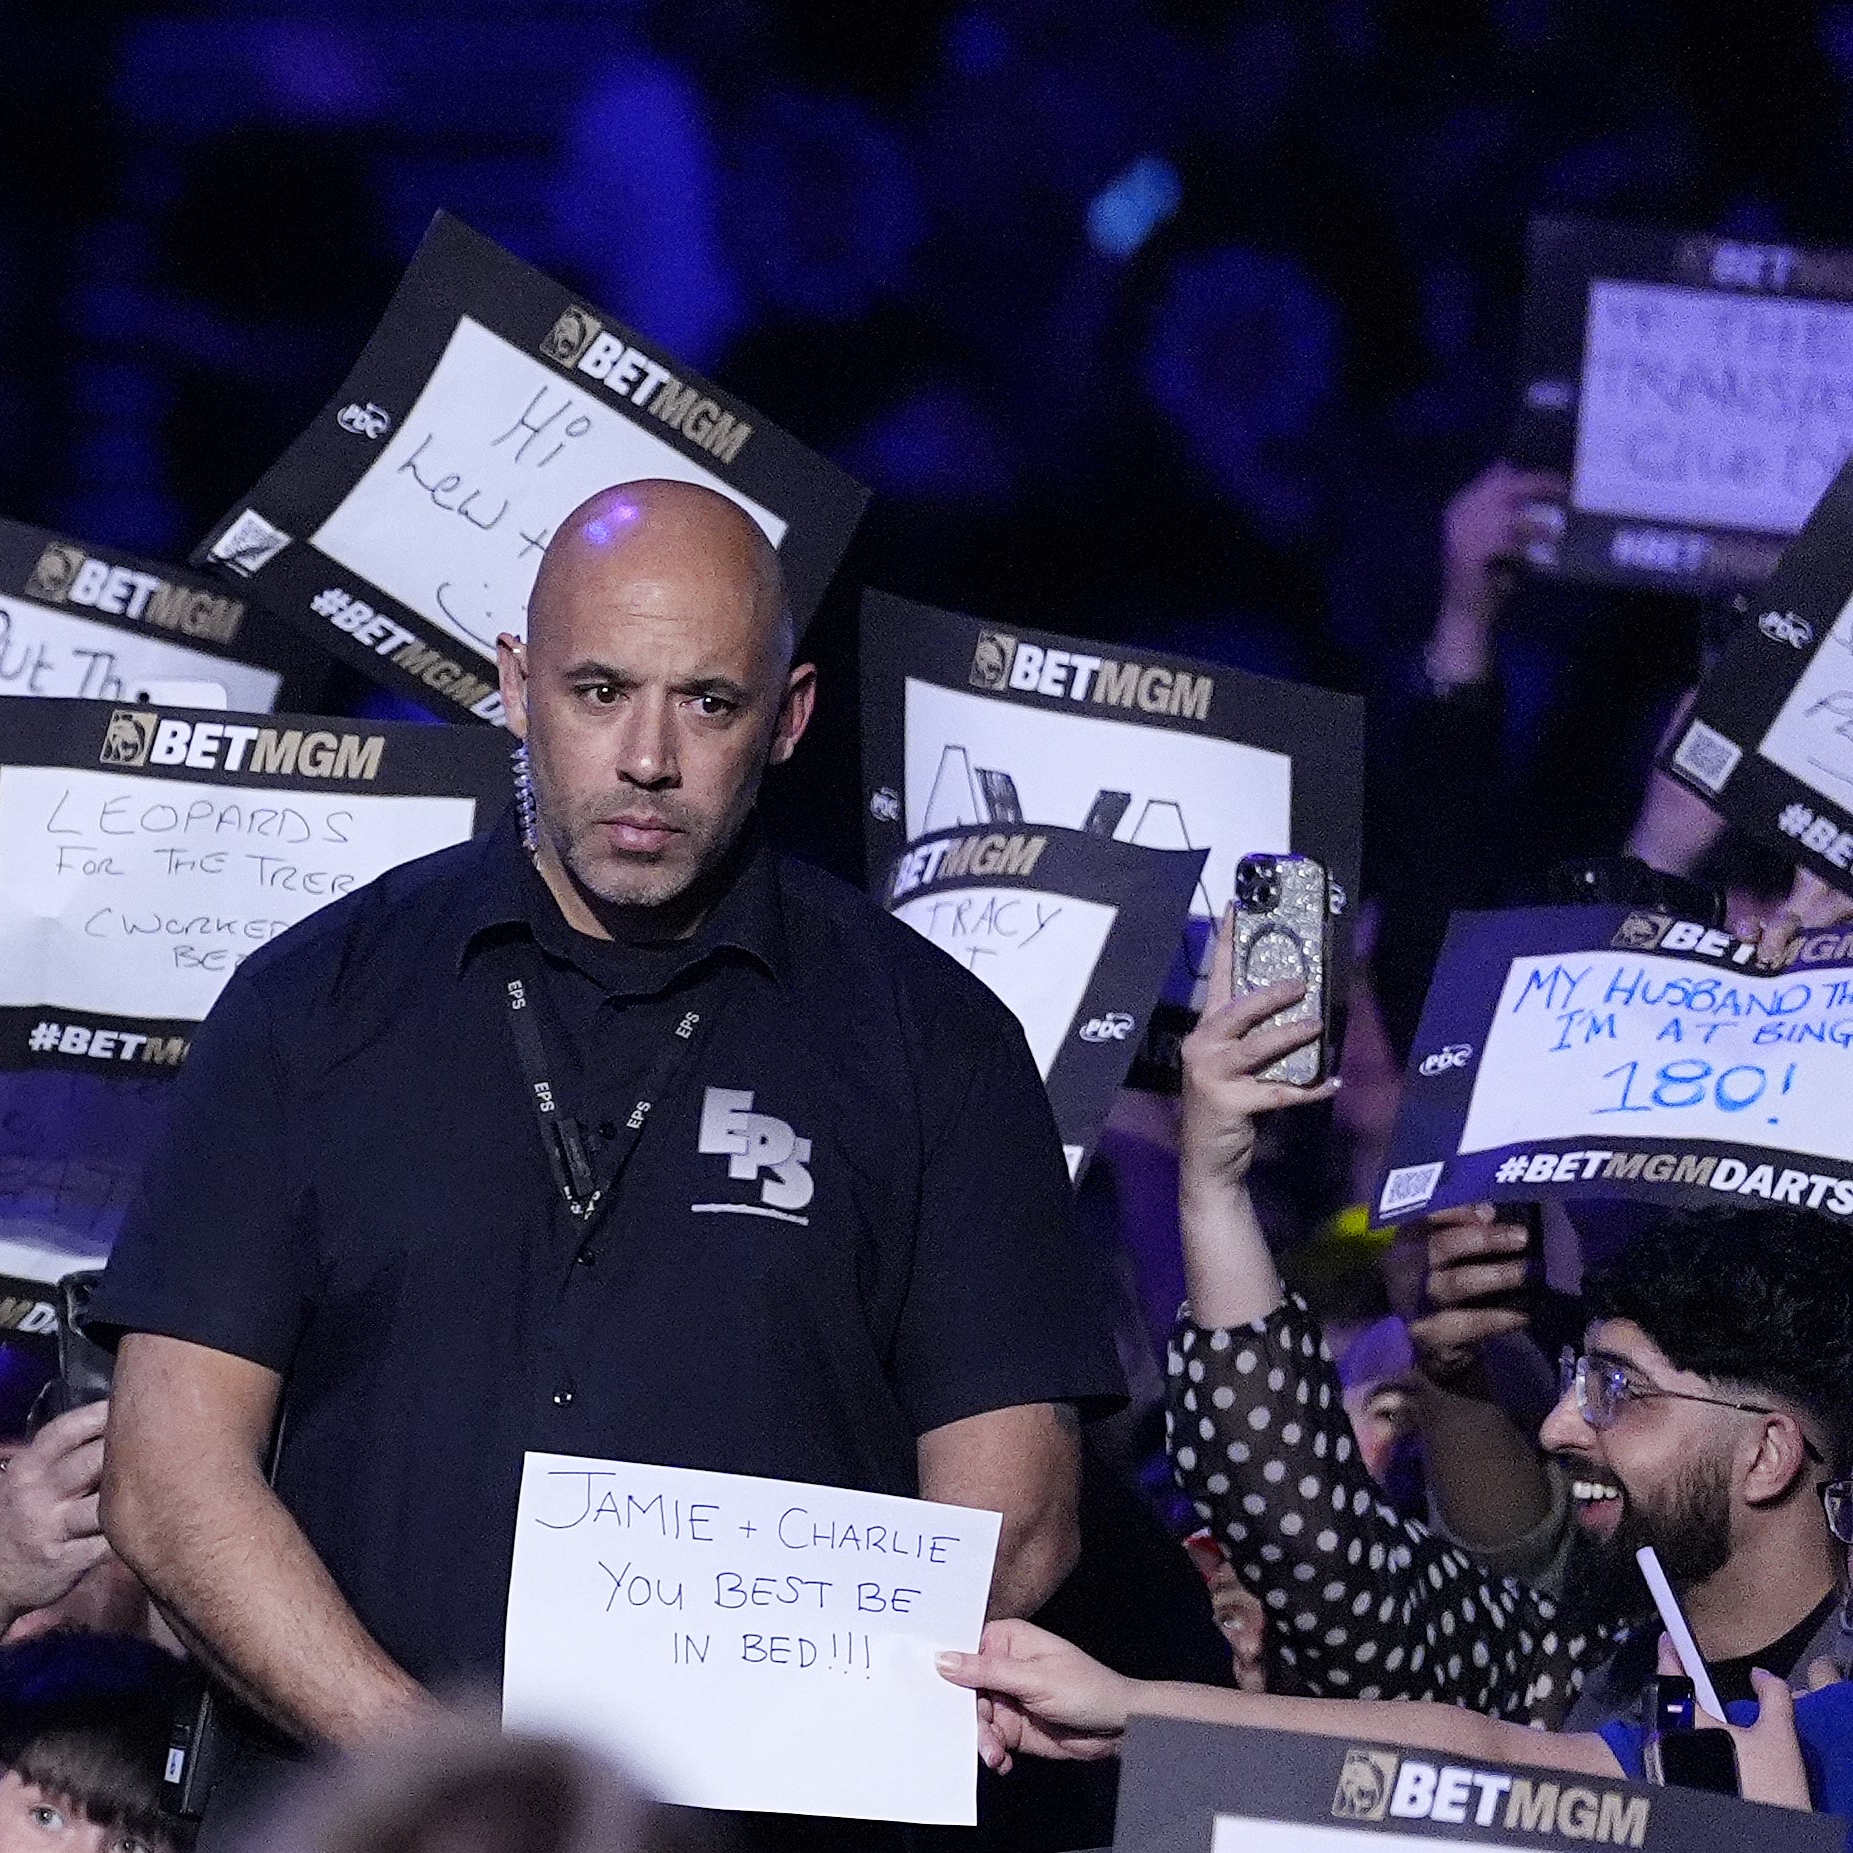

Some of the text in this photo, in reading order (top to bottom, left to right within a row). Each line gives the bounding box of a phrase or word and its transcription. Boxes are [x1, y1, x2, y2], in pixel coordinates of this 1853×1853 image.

[492, 384, 595, 468] Hi
[579, 331, 753, 464] BETMGM
[68, 556, 247, 644] BETMGM
[309, 587, 507, 728] #BETMGMD
[1008, 642, 1215, 721] BETMGM
[149, 721, 386, 781] BETMGM
[45, 788, 355, 845] LEOPARDS
[927, 896, 1063, 950] TRACY
[507, 978, 527, 1010] EPS
[1512, 964, 1593, 1014] MY
[1606, 967, 1812, 1017] HUSBAND
[675, 1010, 701, 1040] EPS
[1078, 1010, 1135, 1044] PDC
[1751, 1012, 1853, 1051] BING
[1418, 1043, 1474, 1077] PDC
[625, 1099, 652, 1130] EPS
[1589, 1058, 1799, 1126] 180!
[697, 1086, 815, 1211] EPS
[1495, 1149, 1853, 1219] #BETMGMDARTS
[534, 1470, 962, 1566] JAMIE + CHARLIE
[597, 1560, 923, 1615] YOU BEST BE
[673, 1630, 873, 1682] IN BED!!!
[1389, 1760, 1653, 1849] BETMGM
